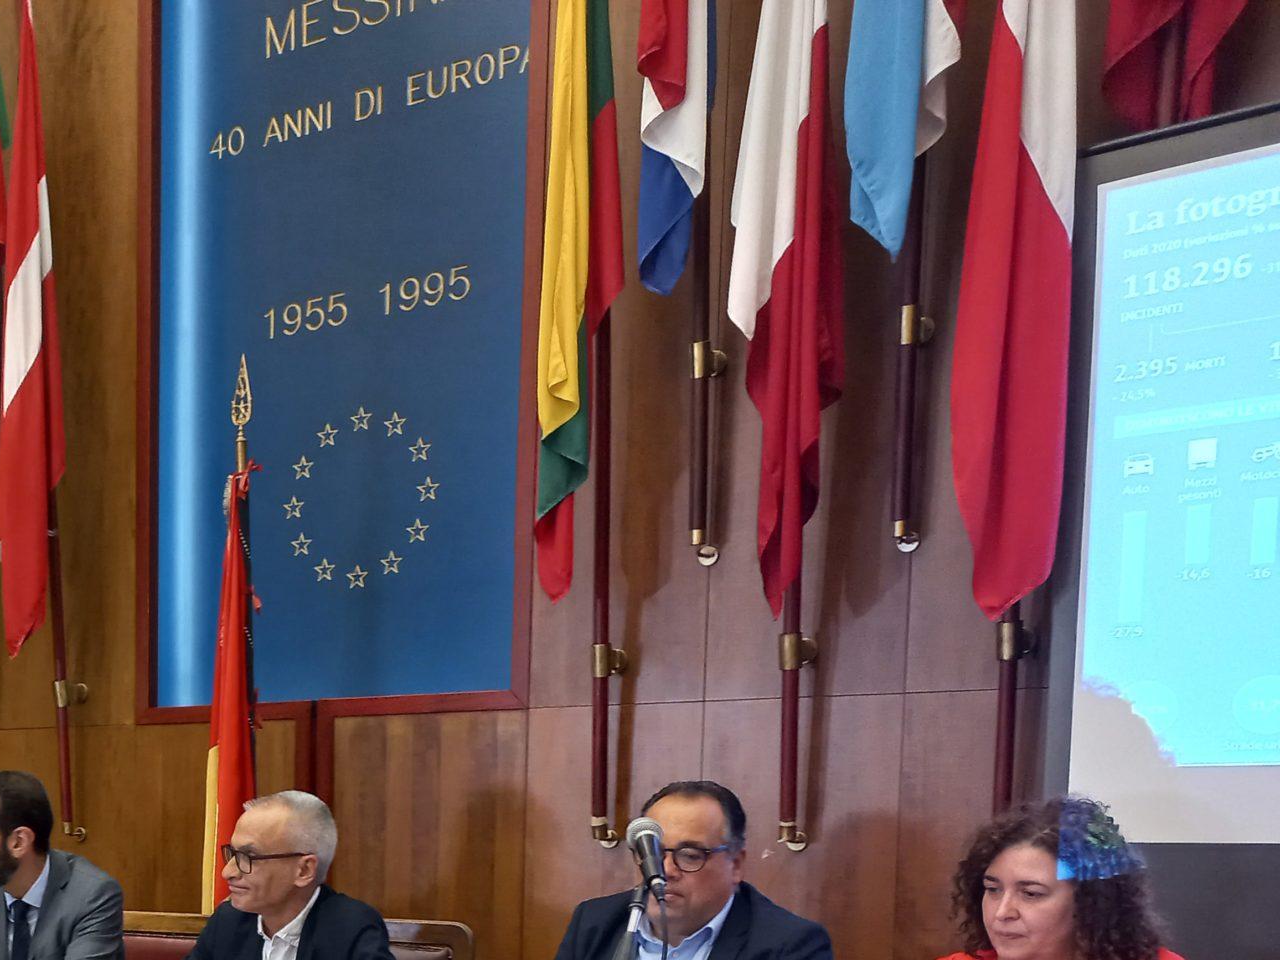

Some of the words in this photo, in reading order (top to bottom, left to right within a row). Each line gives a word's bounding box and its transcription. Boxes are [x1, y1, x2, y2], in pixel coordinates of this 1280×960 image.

[208, 125, 245, 159] 40
[263, 101, 332, 147] ANNI
[354, 85, 383, 121] DI
[1125, 210, 1165, 236] La
[1122, 253, 1253, 299] 118.296
[263, 292, 349, 339] 1955
[379, 265, 471, 316] 1995
[1120, 302, 1184, 322] INCIDENTI
[1113, 355, 1179, 383] 2.395
